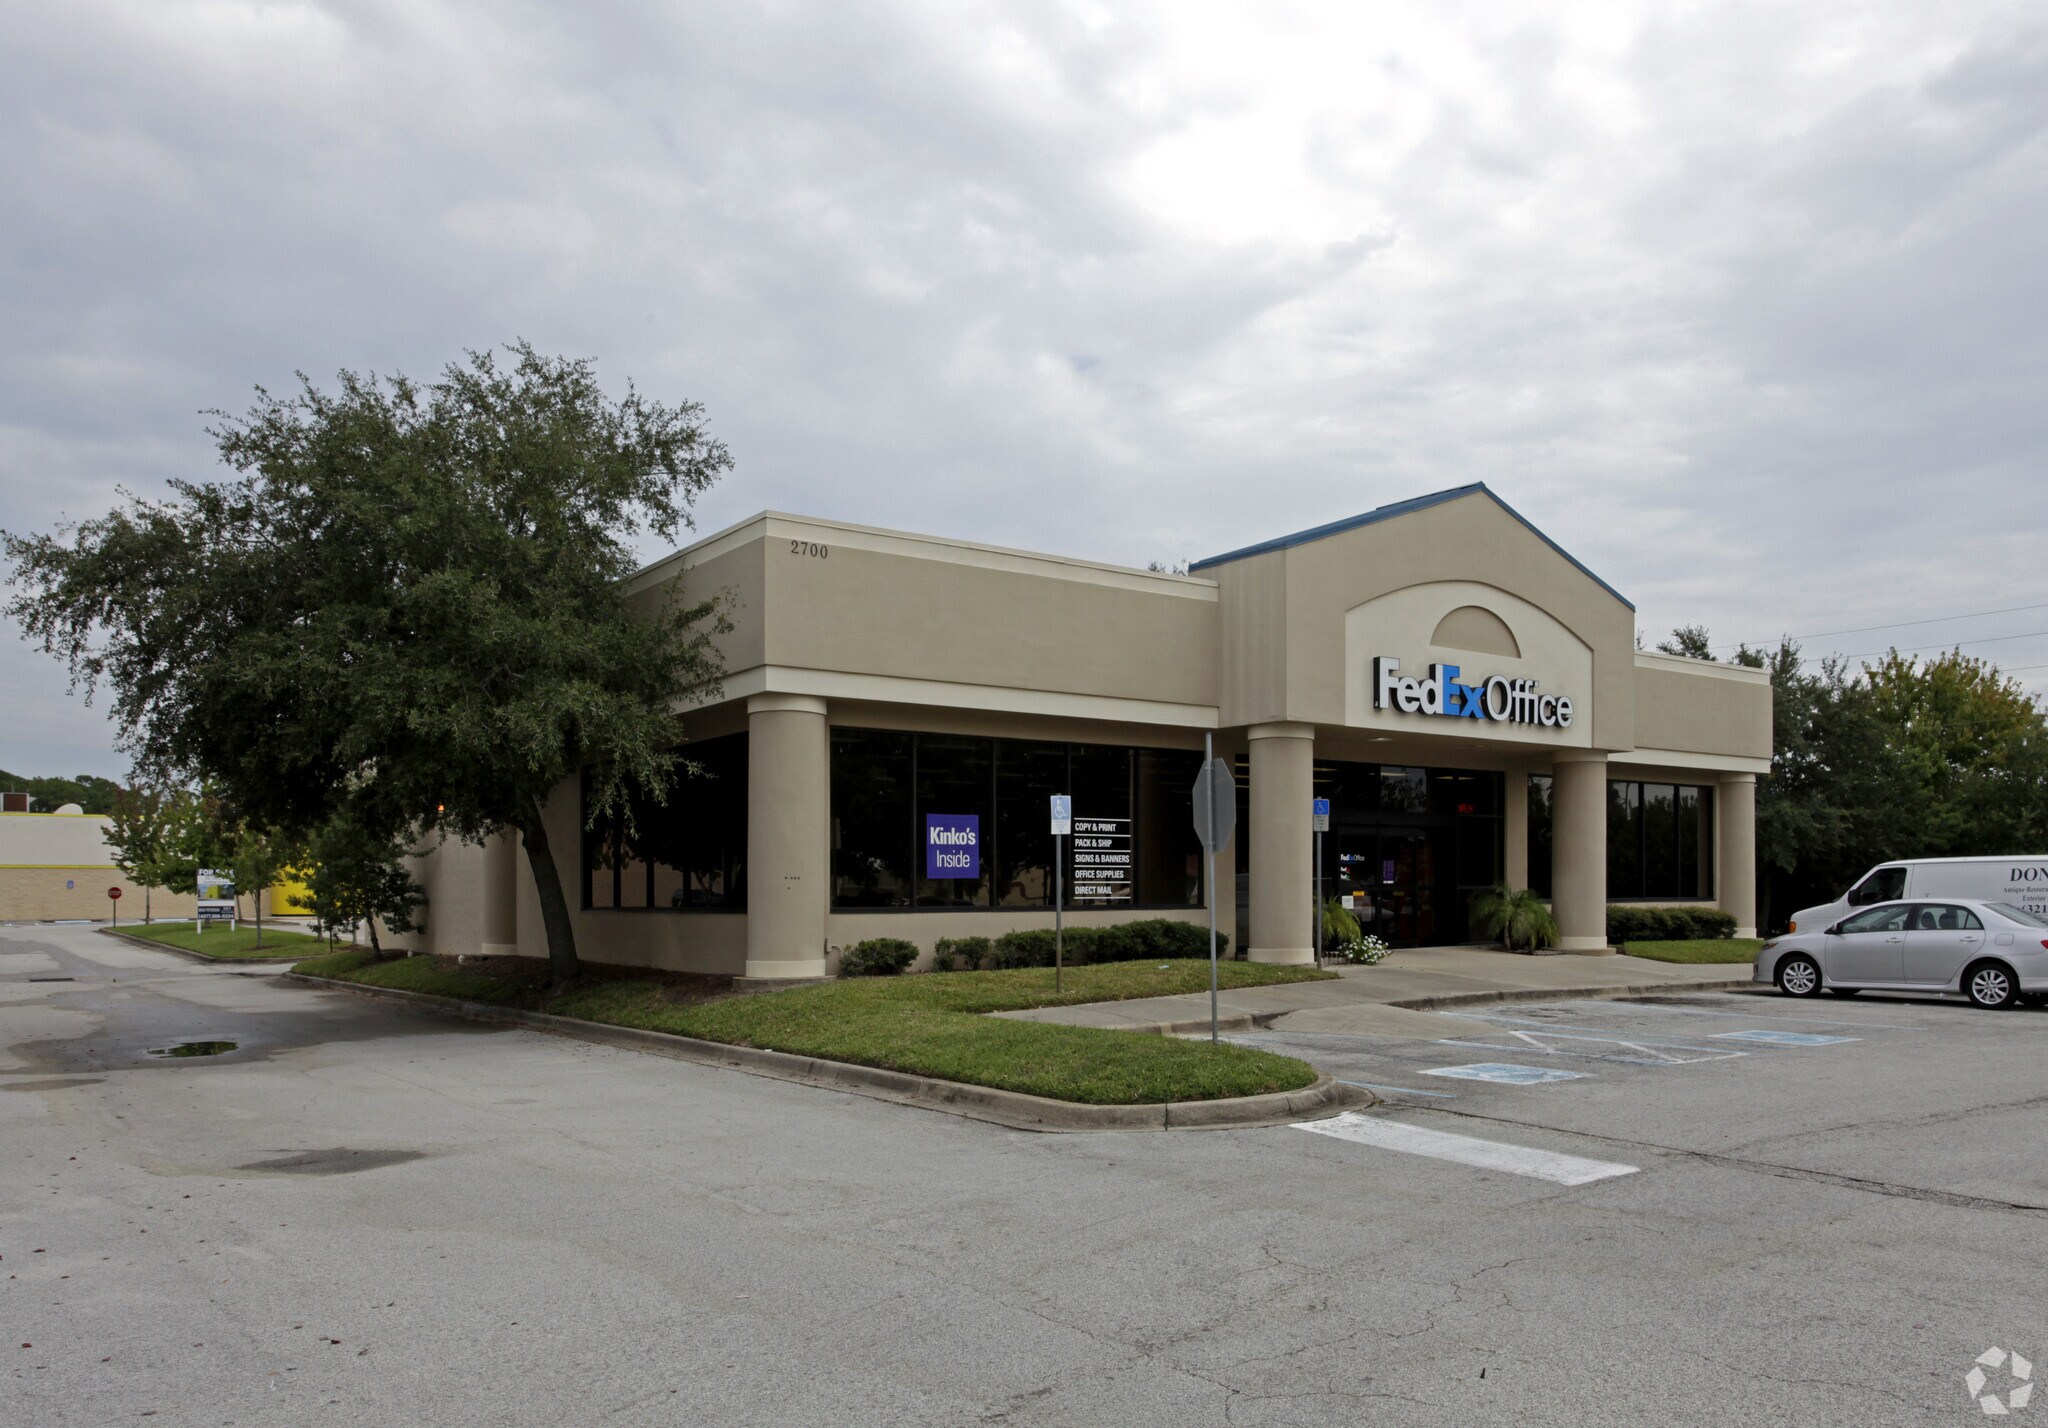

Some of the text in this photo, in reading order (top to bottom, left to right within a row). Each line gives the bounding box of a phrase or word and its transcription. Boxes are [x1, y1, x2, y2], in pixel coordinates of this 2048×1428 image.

[791, 540, 828, 559] 2700
[1373, 656, 1574, 728] FedEx Office
[1074, 822, 1092, 832] COPY
[1092, 823, 1097, 832] &
[1098, 823, 1117, 832] PRINT
[930, 826, 976, 845] Kinko's
[1074, 838, 1112, 848] PACK & SHIP
[936, 850, 970, 868] Inside
[1074, 854, 1130, 863] SIGNS & BANNERS
[198, 868, 214, 876] FOR
[1074, 870, 1124, 879] OFFICE SUPPLIES
[1074, 886, 1112, 895] DIRECT MAIL
